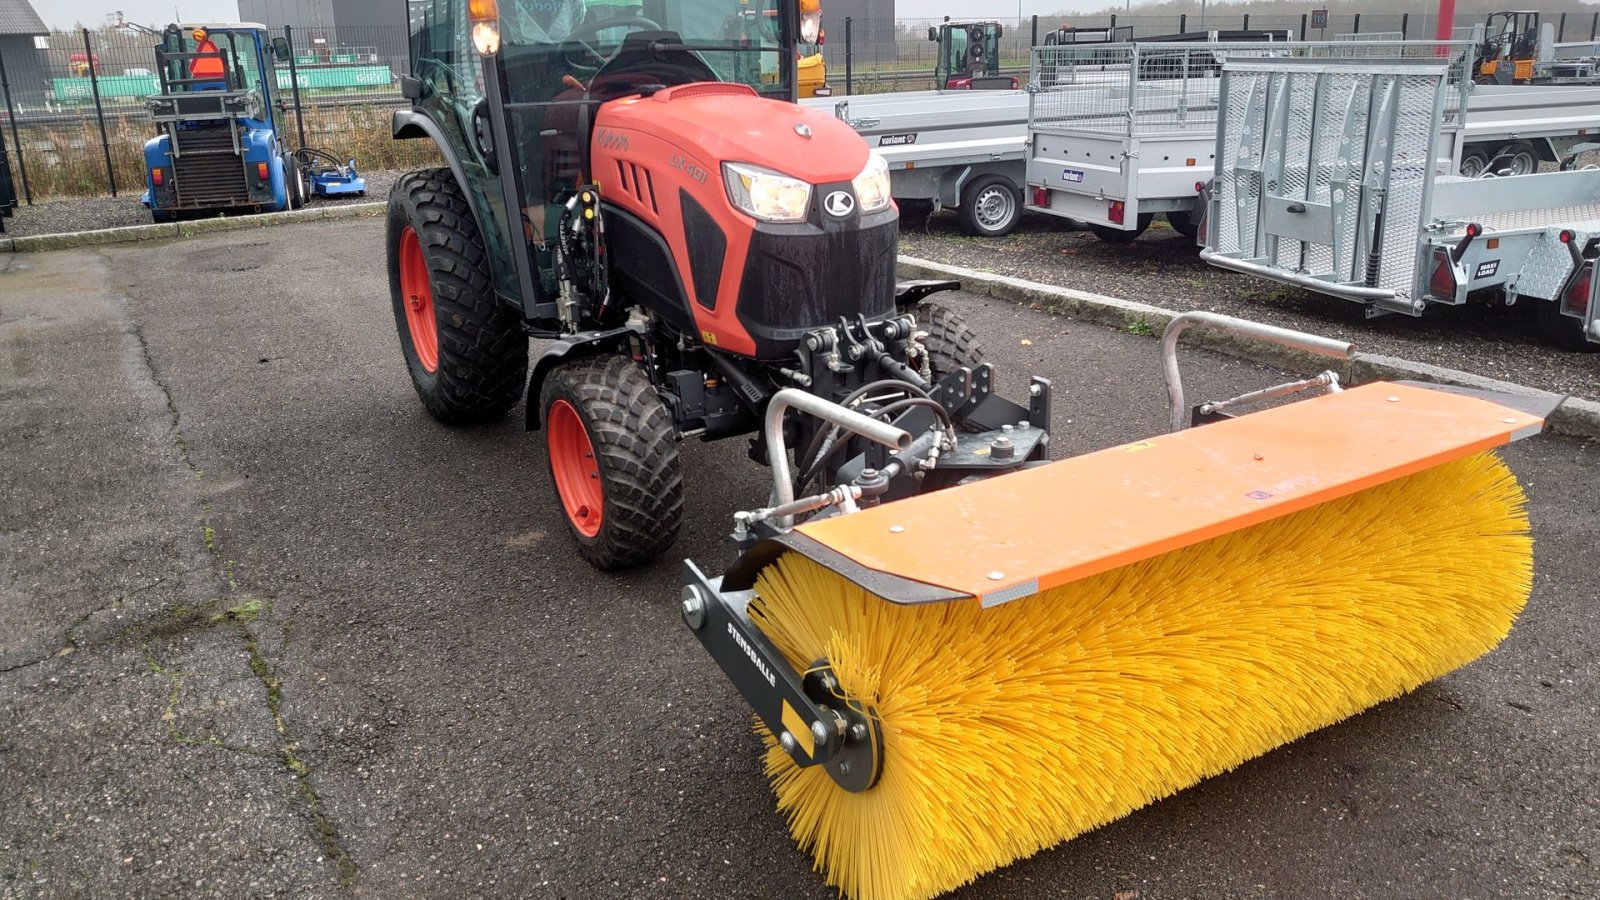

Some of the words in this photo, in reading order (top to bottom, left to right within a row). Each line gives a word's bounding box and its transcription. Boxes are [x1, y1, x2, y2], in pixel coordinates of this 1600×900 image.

[881, 135, 906, 145] variant
[1479, 262, 1497, 271] MAXI
[1477, 268, 1496, 277] LOAD
[727, 622, 776, 688] STENSBALLE
